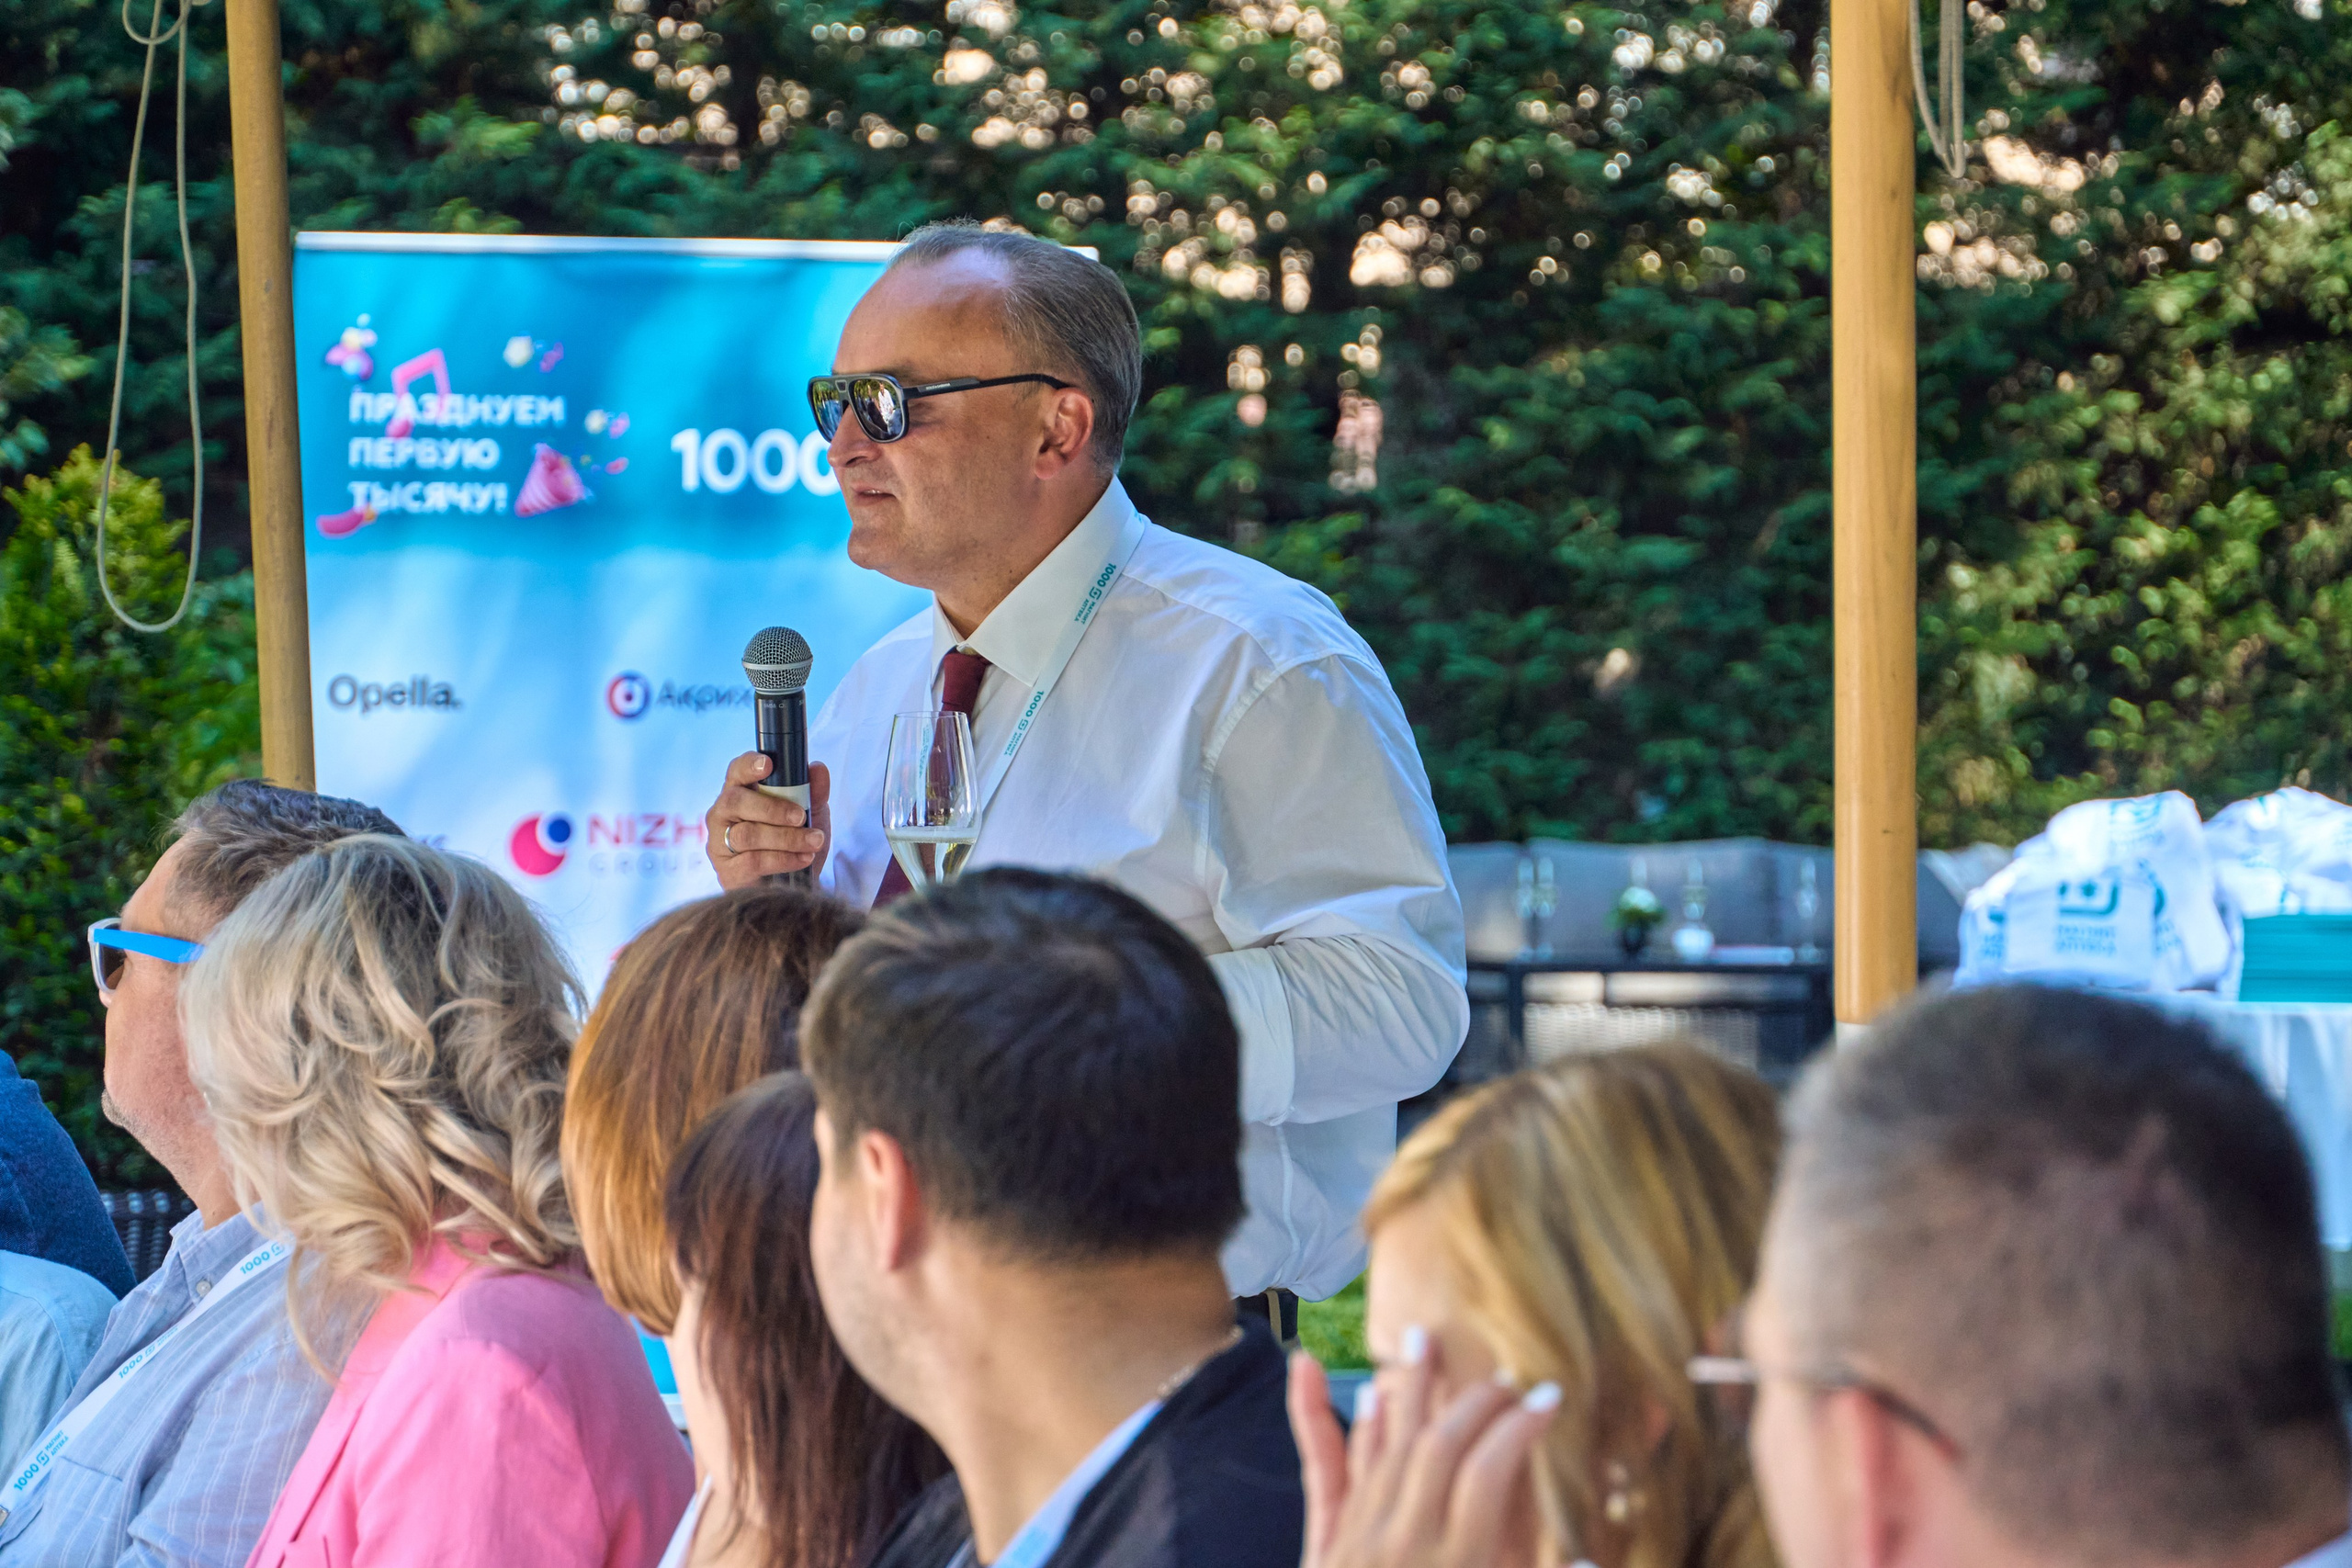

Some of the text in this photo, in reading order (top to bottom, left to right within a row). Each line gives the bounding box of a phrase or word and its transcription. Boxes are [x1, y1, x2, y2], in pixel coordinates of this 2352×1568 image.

[349, 392, 567, 429] ПРАЗДНУЕМ
[349, 437, 501, 469] ПЕРВУЮ
[671, 428, 841, 496] 1000
[348, 481, 510, 514] ТЫСЯЧУ!
[1097, 562, 1117, 588] 1000
[1074, 598, 1090, 622] АПТЕКА
[1080, 601, 1096, 625] МАГНИТ
[328, 673, 463, 715] Opella.
[1025, 691, 1045, 717] 1000
[240, 1250, 270, 1275] 1000
[118, 1354, 143, 1379] 1000
[44, 1429, 64, 1451] МАГНИТ
[51, 1435, 69, 1456] АПТЕКА
[14, 1463, 40, 1491] 1000
